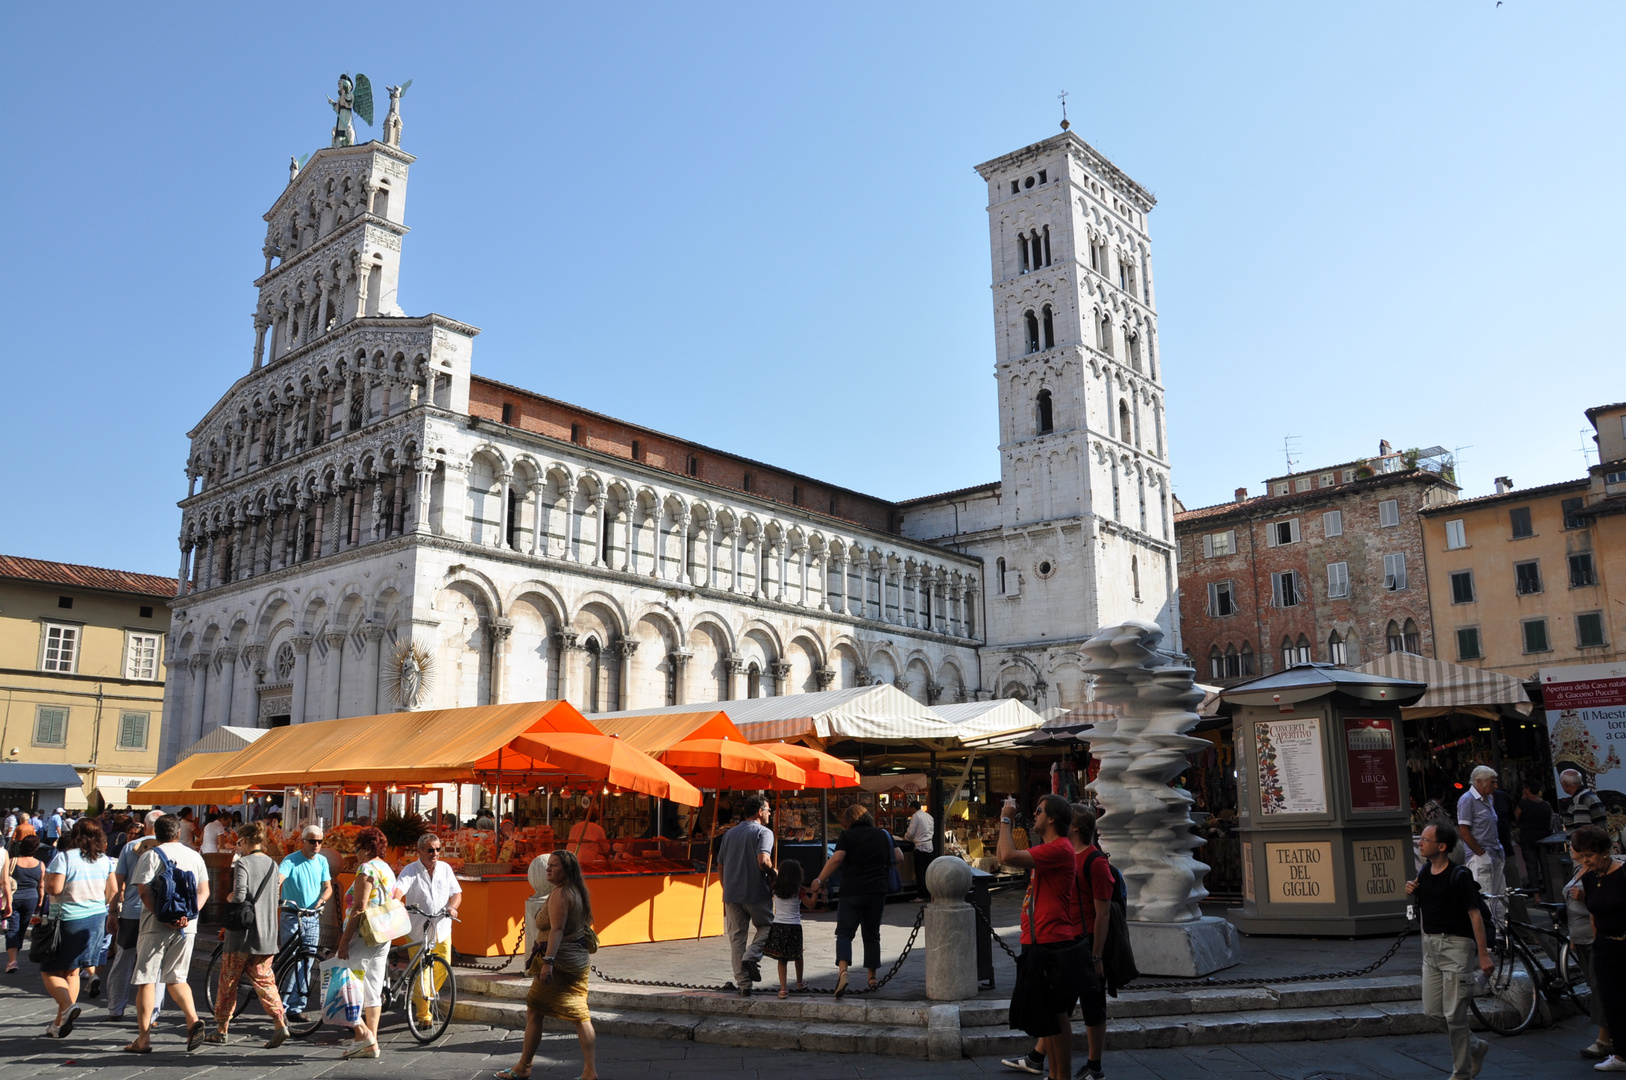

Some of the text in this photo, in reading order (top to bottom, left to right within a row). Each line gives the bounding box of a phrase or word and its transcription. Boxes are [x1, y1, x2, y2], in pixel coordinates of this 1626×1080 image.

[1545, 686, 1573, 694] Apertura
[1583, 711, 1589, 720] Il
[1269, 723, 1305, 737] CONCERTI
[1606, 732, 1612, 740] a
[1361, 774, 1387, 783] LIRICA
[1276, 848, 1321, 864] TEATRO
[1360, 845, 1395, 862] TEATRO
[1289, 865, 1311, 880] DEL
[1371, 862, 1388, 878] DEL
[1282, 881, 1320, 897] GIGLIO
[1366, 878, 1396, 895] GIGLIO
